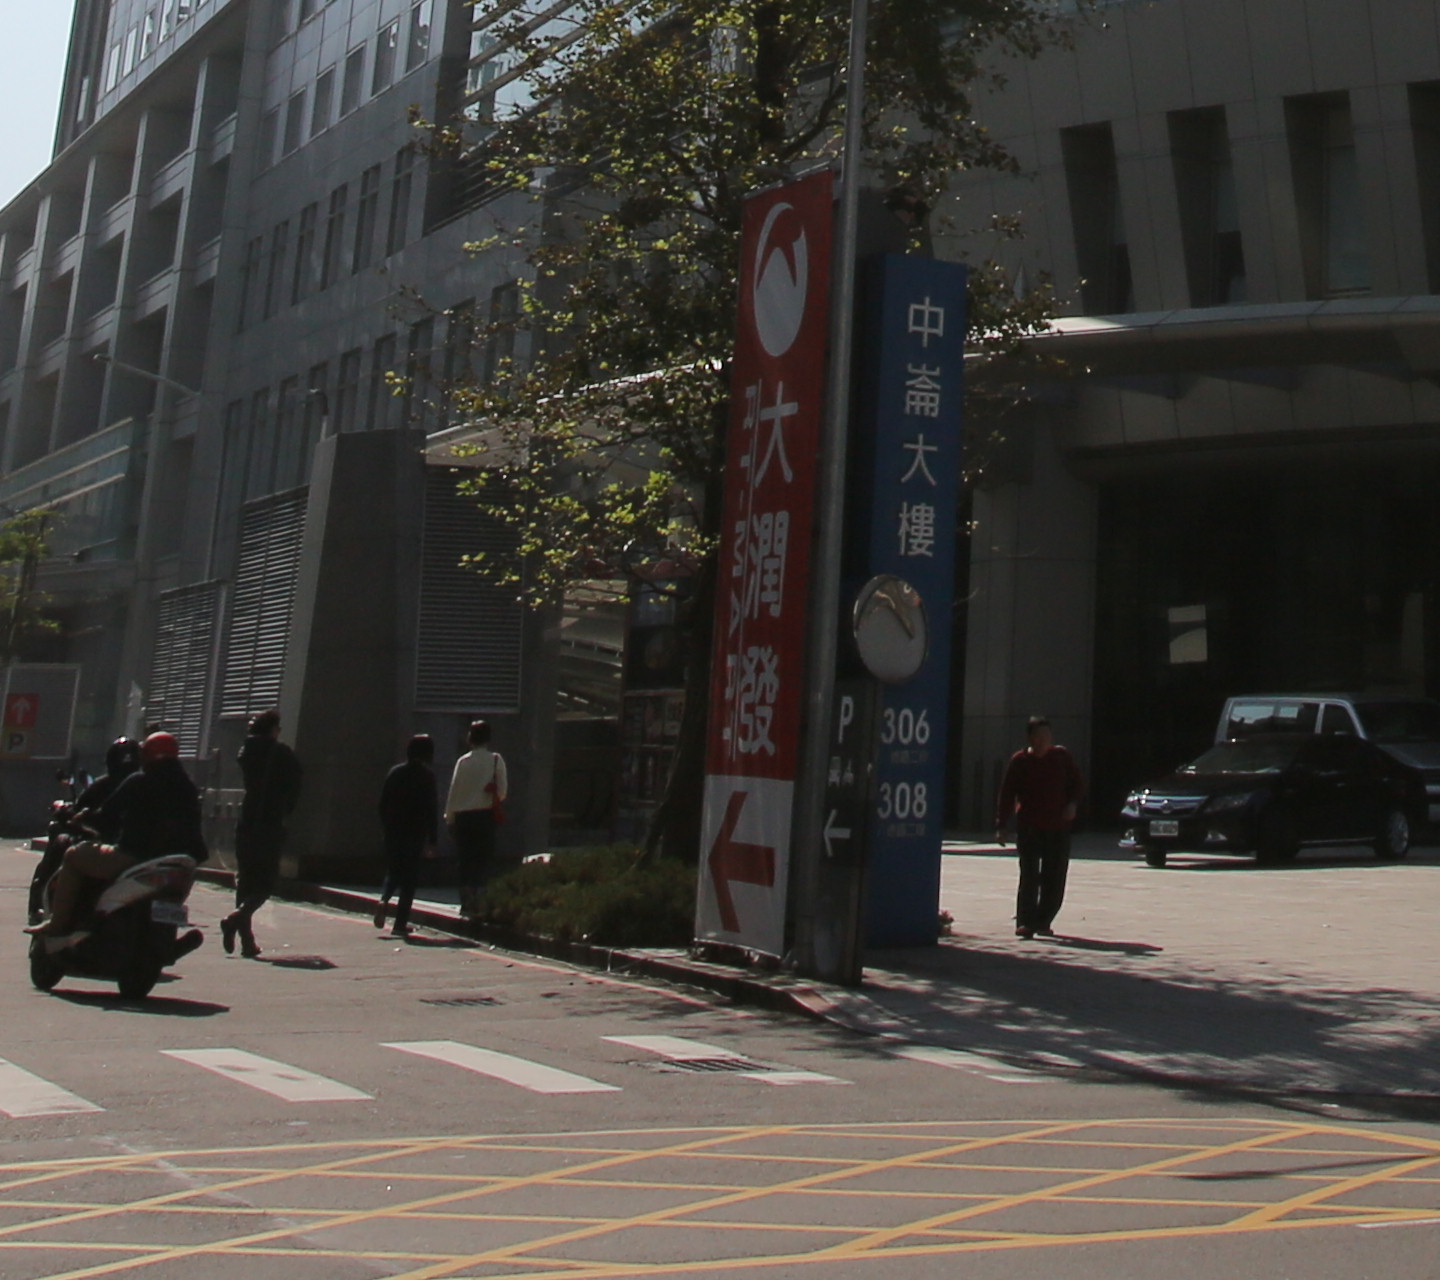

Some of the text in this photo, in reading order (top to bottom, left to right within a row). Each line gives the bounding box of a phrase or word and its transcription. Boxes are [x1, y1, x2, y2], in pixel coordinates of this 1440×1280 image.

[898, 295, 946, 558] 中崙大樓
[739, 379, 800, 758] 大潤發
[838, 695, 855, 745] P
[880, 706, 931, 746] 306
[876, 781, 929, 820] 308
